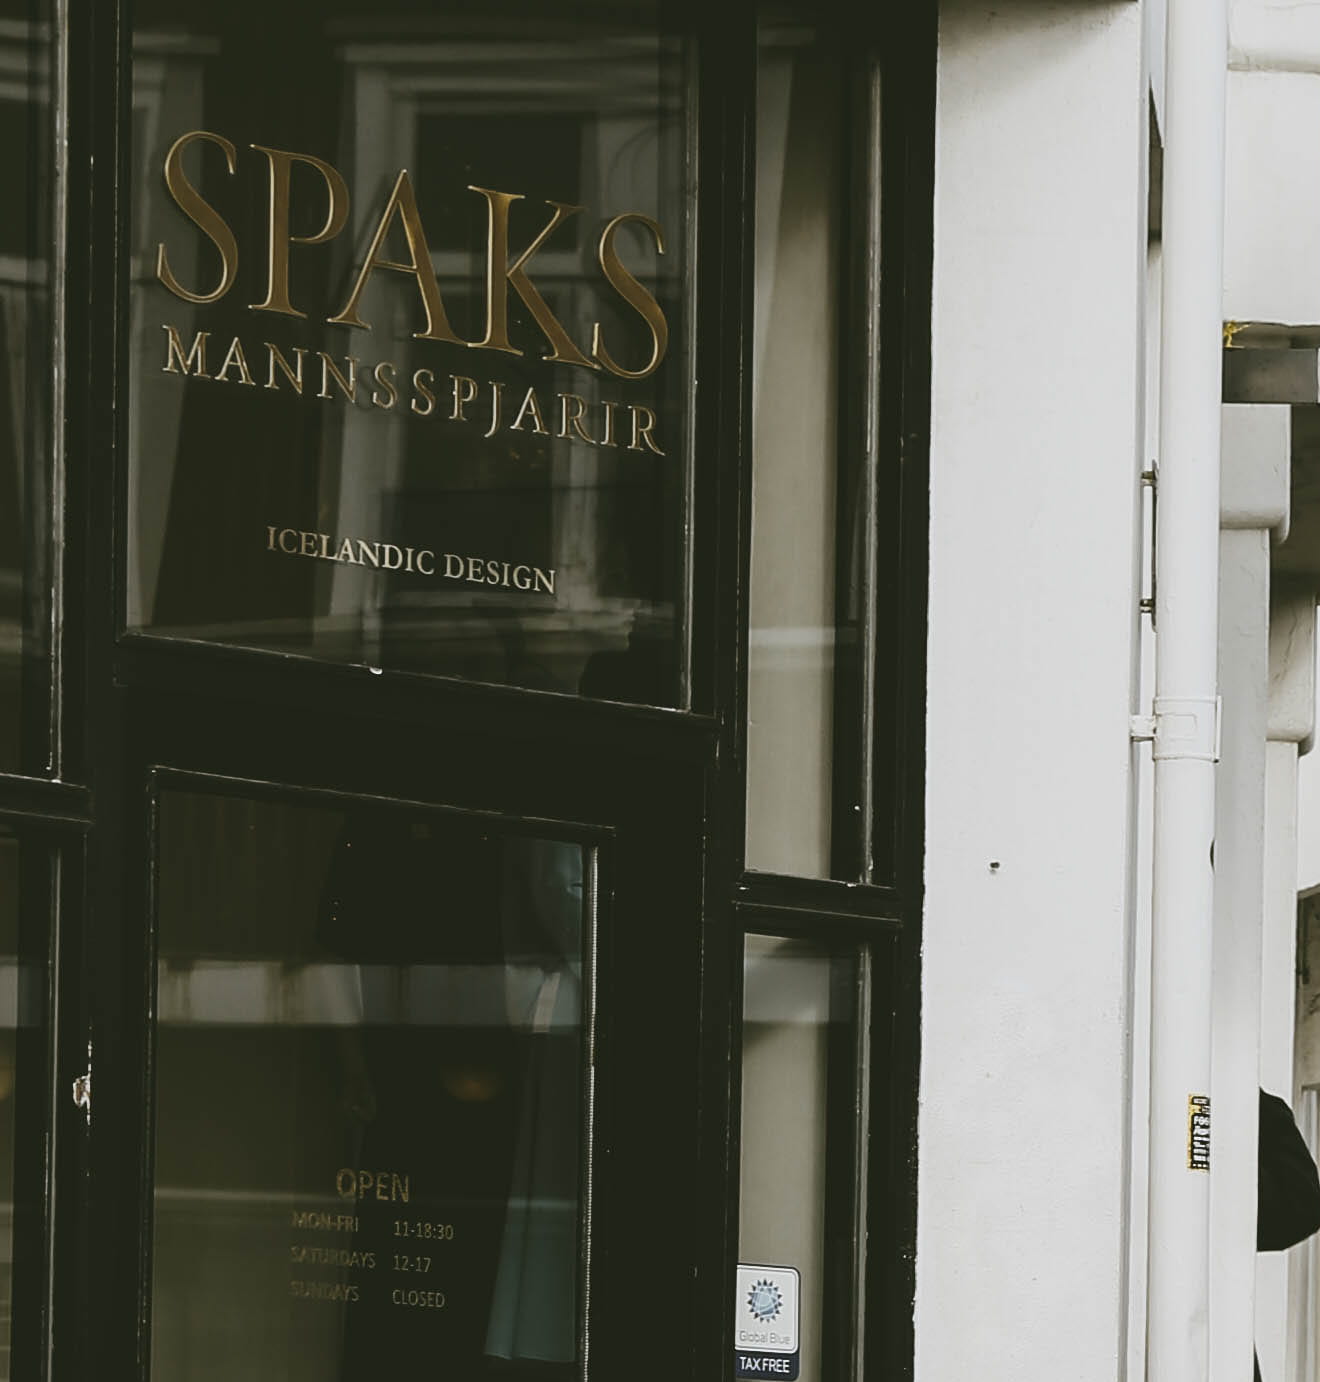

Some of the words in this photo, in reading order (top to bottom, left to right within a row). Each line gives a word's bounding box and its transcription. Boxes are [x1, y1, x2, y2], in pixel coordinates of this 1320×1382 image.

[155, 129, 669, 381] SPAKS
[161, 324, 667, 457] MANNSSPJARIR
[266, 525, 435, 576] ICELANDIC
[444, 553, 556, 595] DESIGN
[336, 1167, 410, 1203] OPEN
[292, 1210, 359, 1233] MON-FRI
[394, 1220, 454, 1241] 11-18:30
[394, 1255, 433, 1274] 12-17
[392, 1289, 446, 1309] CLOSED
[739, 1356, 761, 1371] TAX
[762, 1358, 791, 1374] FREE
